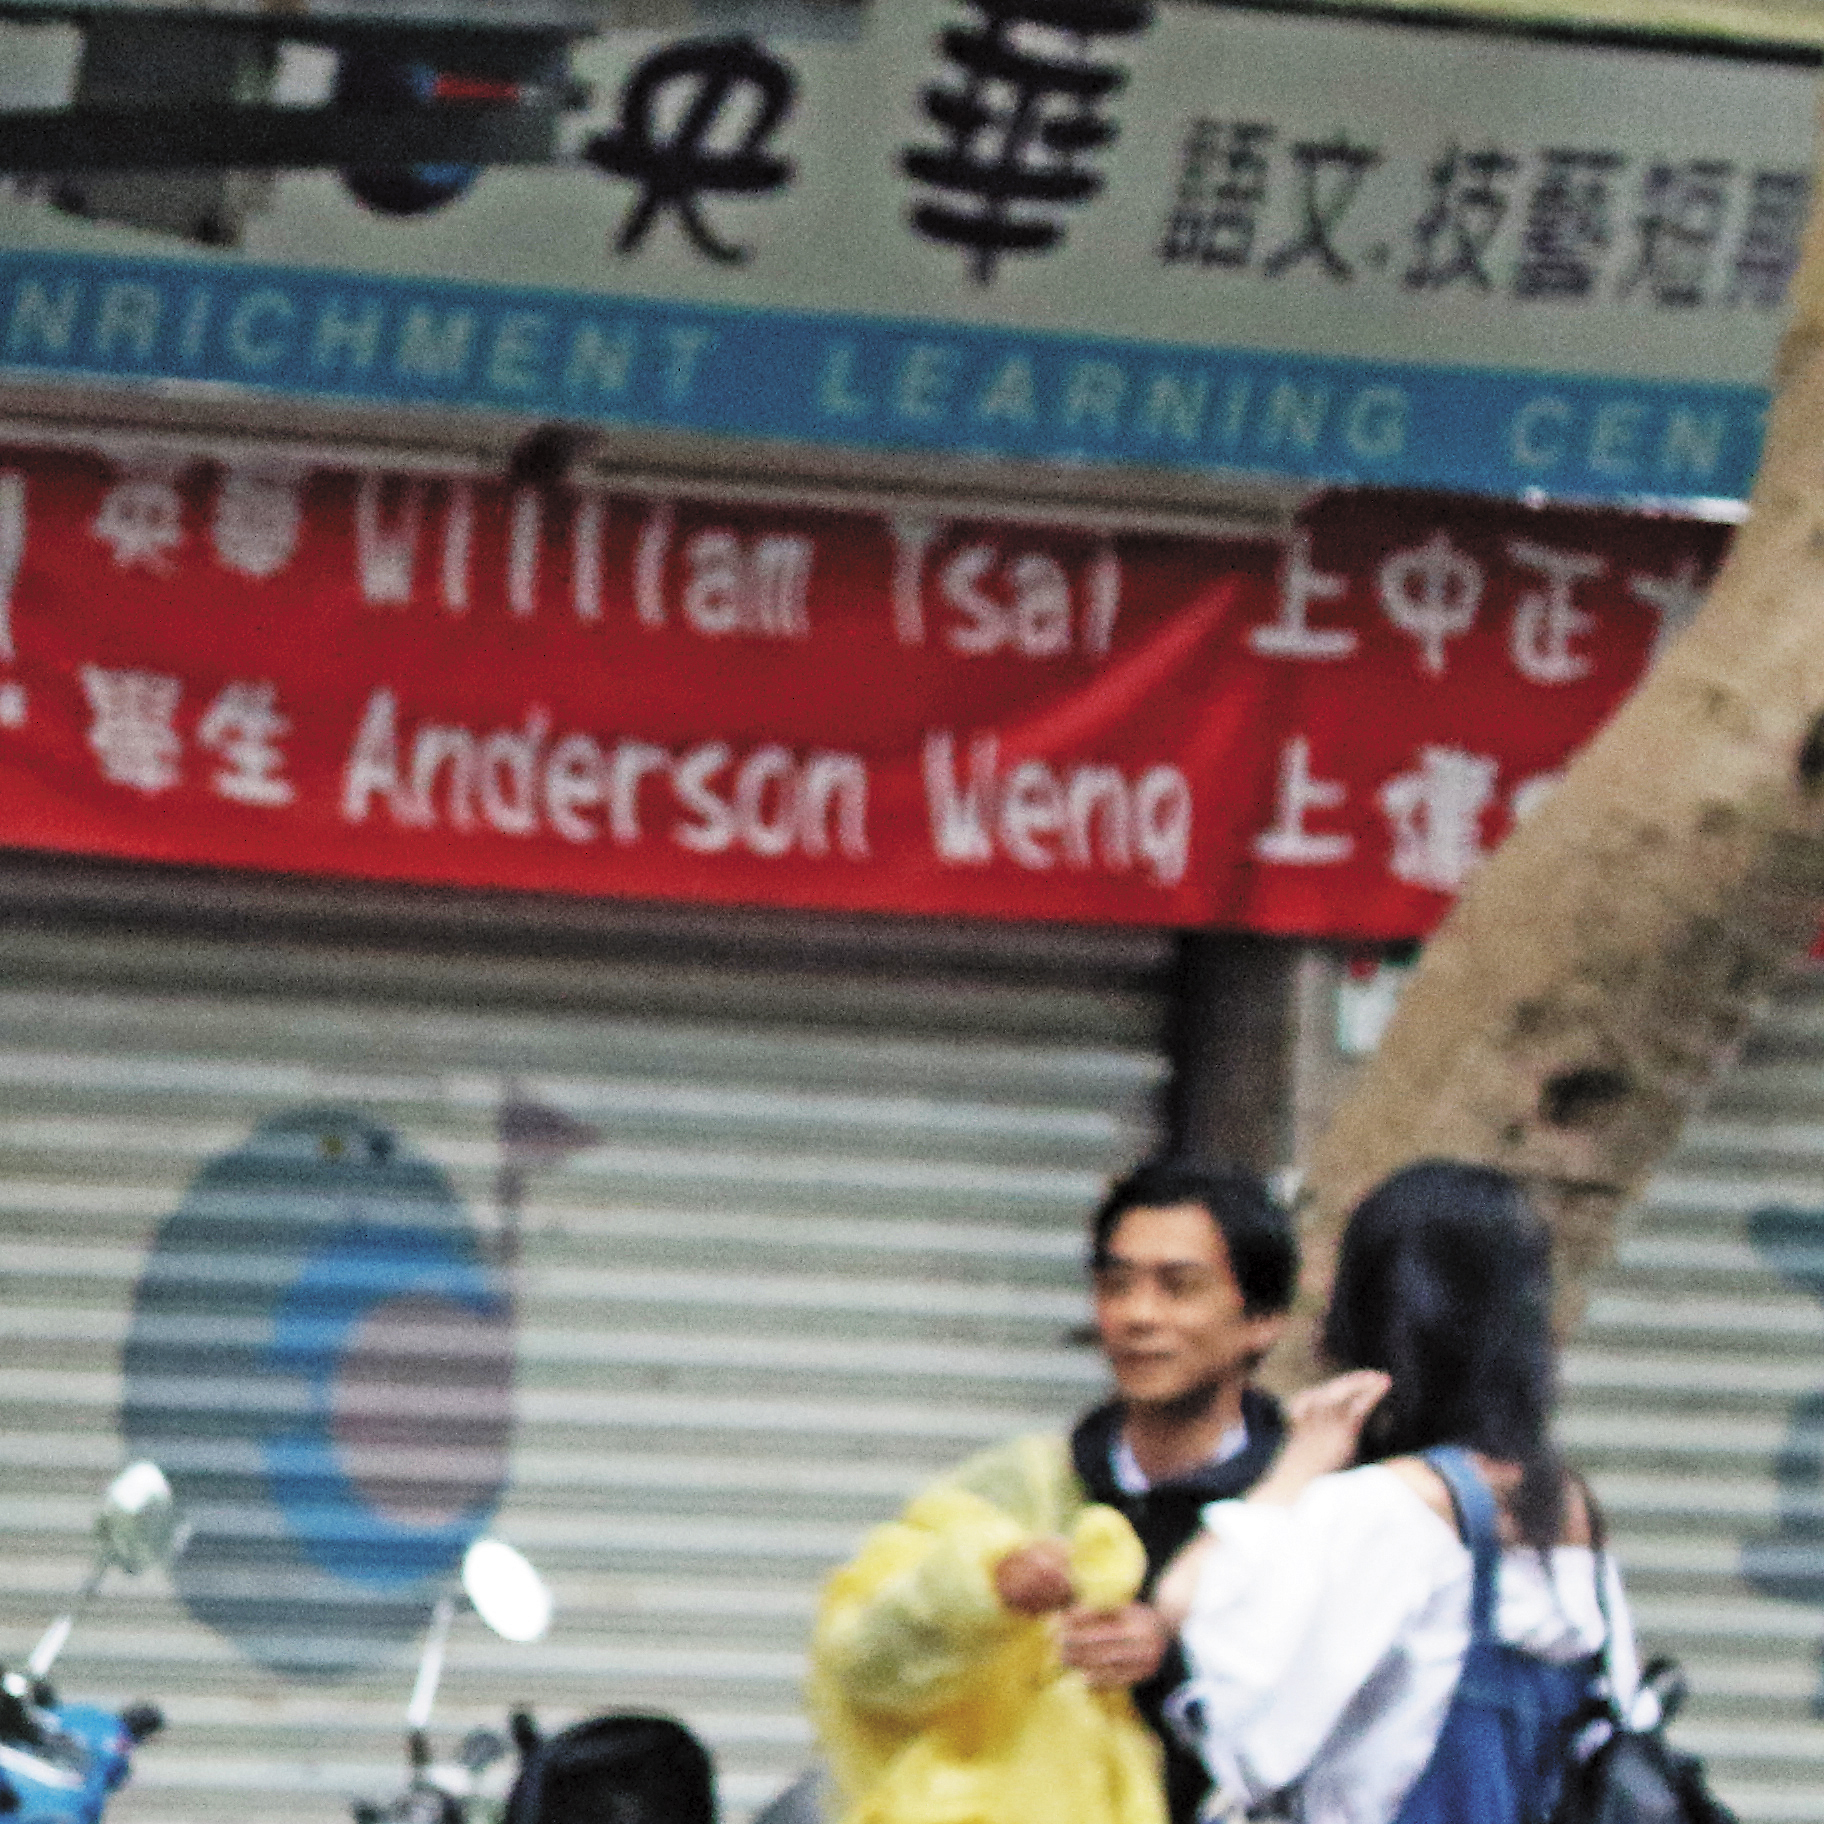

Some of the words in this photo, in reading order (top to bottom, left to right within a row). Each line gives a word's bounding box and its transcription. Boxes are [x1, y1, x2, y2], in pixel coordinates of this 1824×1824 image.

[817, 337, 1410, 464] LEARNING
[1509, 395, 1760, 478] CEN
[354, 472, 816, 640] William
[889, 505, 1124, 660] Tsai
[342, 687, 869, 866] Anderson
[922, 728, 1194, 889] Weng
